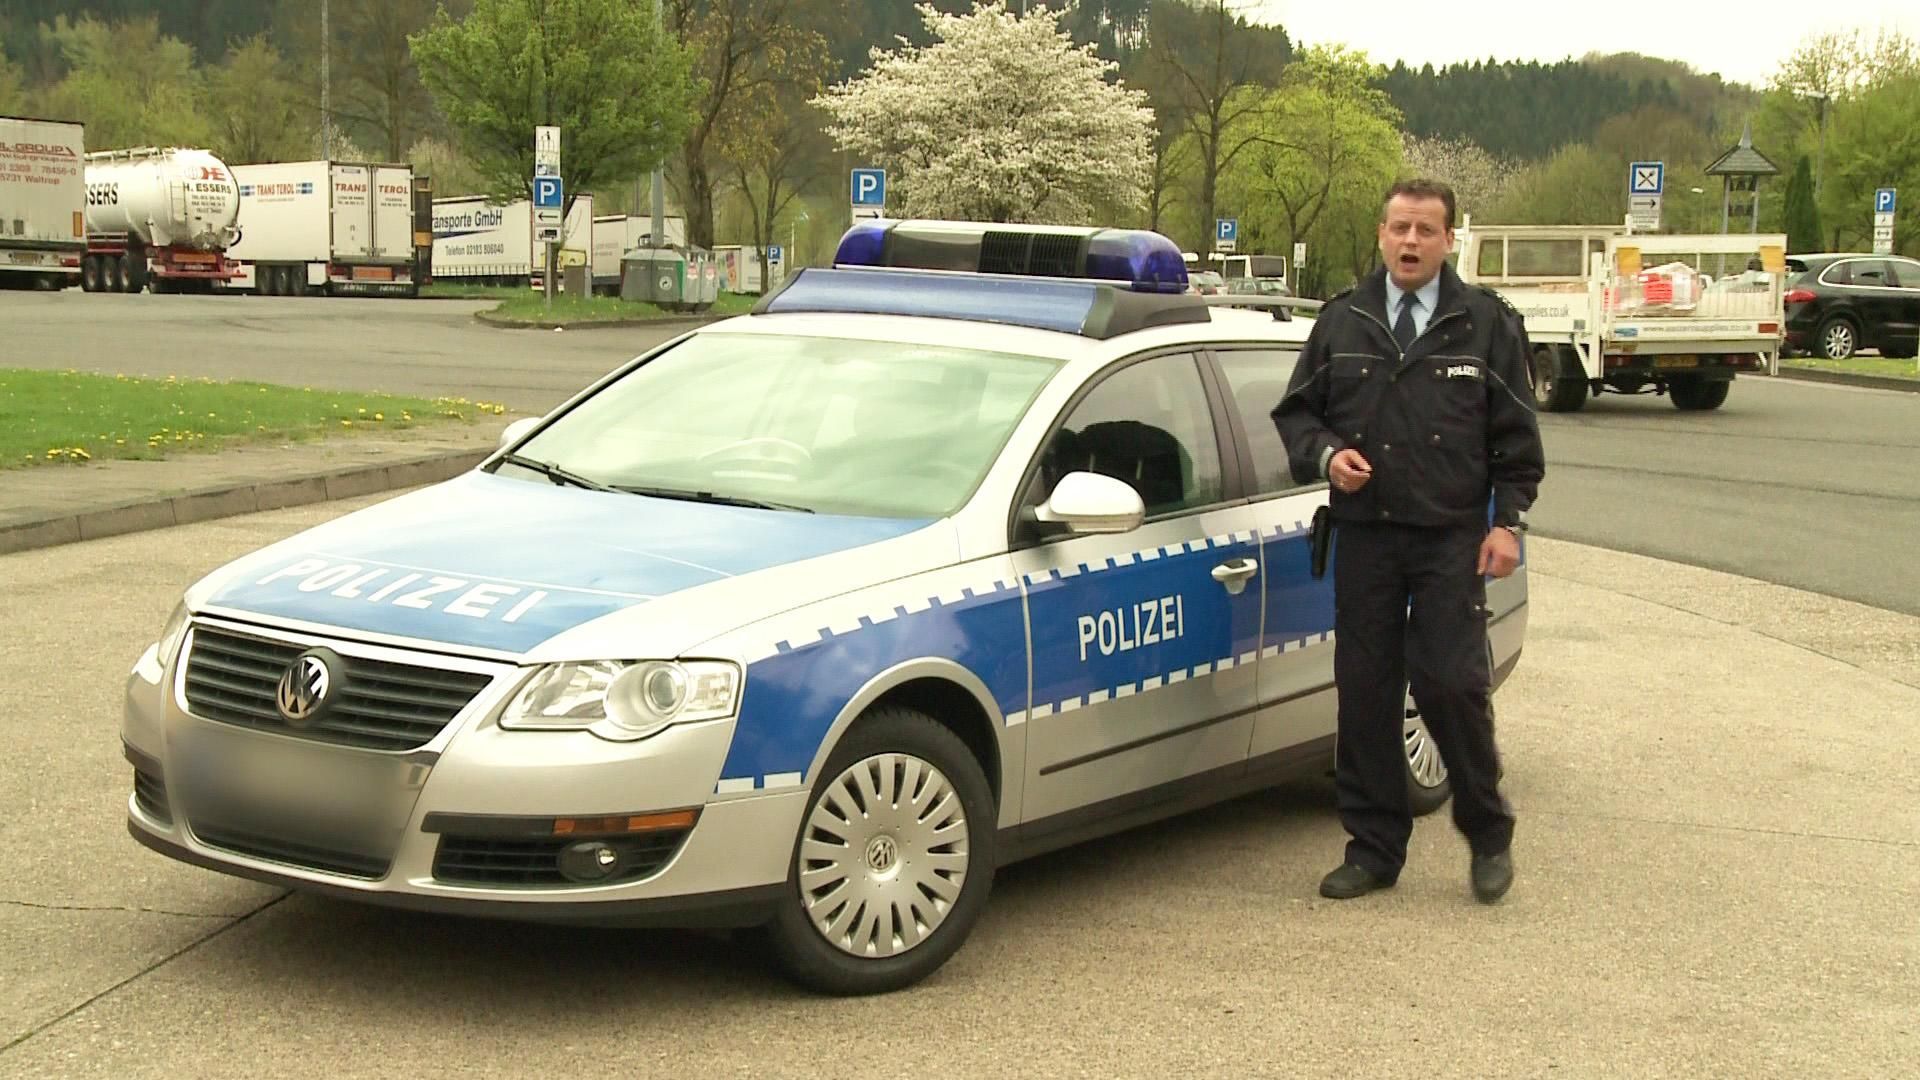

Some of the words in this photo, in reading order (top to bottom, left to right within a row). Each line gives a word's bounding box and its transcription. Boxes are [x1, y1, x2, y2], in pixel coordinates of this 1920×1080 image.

[25, 175, 60, 185] Waltrop
[859, 174, 877, 201] P
[196, 183, 232, 194] ESSERS
[257, 184, 275, 196] TRANS
[276, 183, 295, 195] TEROL
[335, 183, 367, 193] TRANS
[378, 184, 409, 195] TEROL
[540, 181, 555, 204] P
[1879, 192, 1891, 211] P
[432, 211, 472, 232] ransporte
[475, 209, 503, 227] GmbH
[1221, 222, 1232, 238] P
[770, 247, 778, 259] P
[1447, 365, 1479, 378] POLIZEI
[255, 558, 548, 622] POLIZEI
[1078, 594, 1184, 662] POLIZEI
